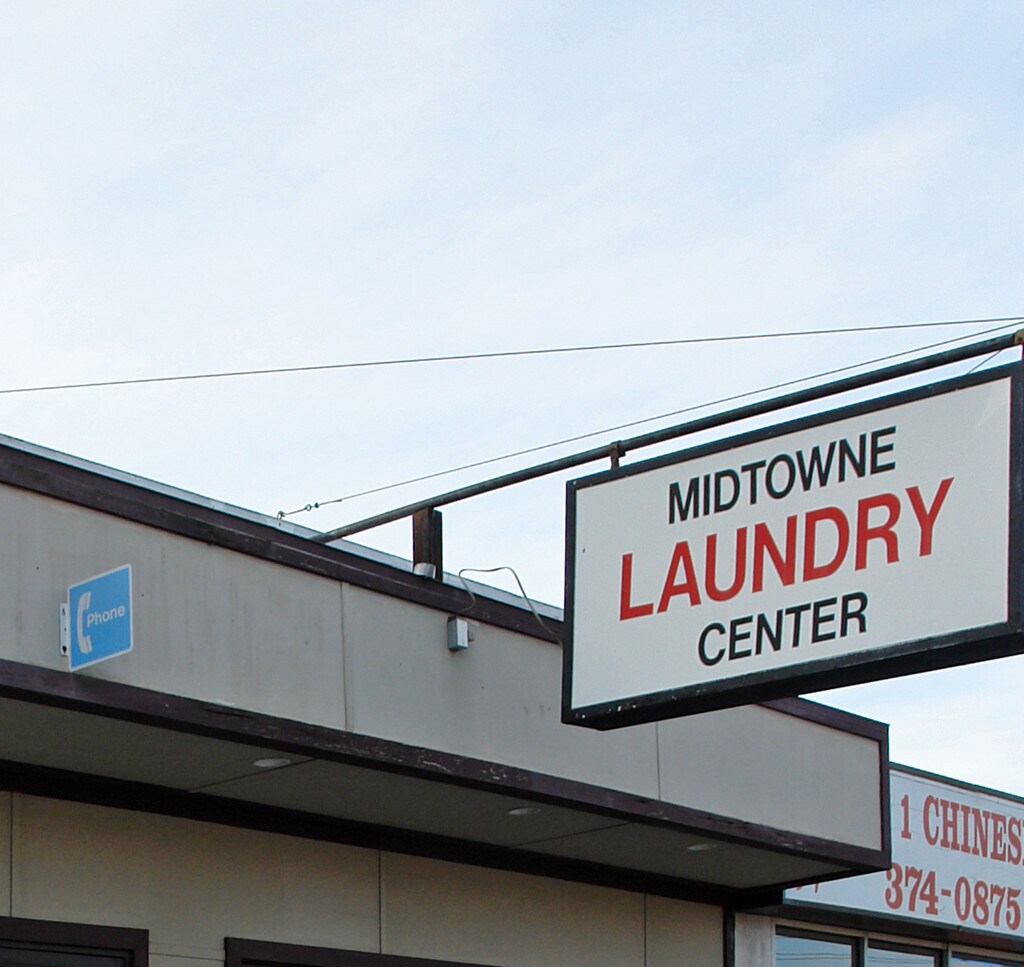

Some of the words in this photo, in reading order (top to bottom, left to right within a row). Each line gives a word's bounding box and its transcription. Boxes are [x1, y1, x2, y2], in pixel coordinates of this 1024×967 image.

[668, 426, 896, 524] MIDTOWNE
[619, 476, 954, 621] LAUNDRY
[86, 605, 126, 628] Phone
[698, 591, 868, 666] CENTER
[901, 794, 912, 839] 1
[923, 795, 1024, 866] CHINES
[885, 862, 1022, 931] 374-0875
